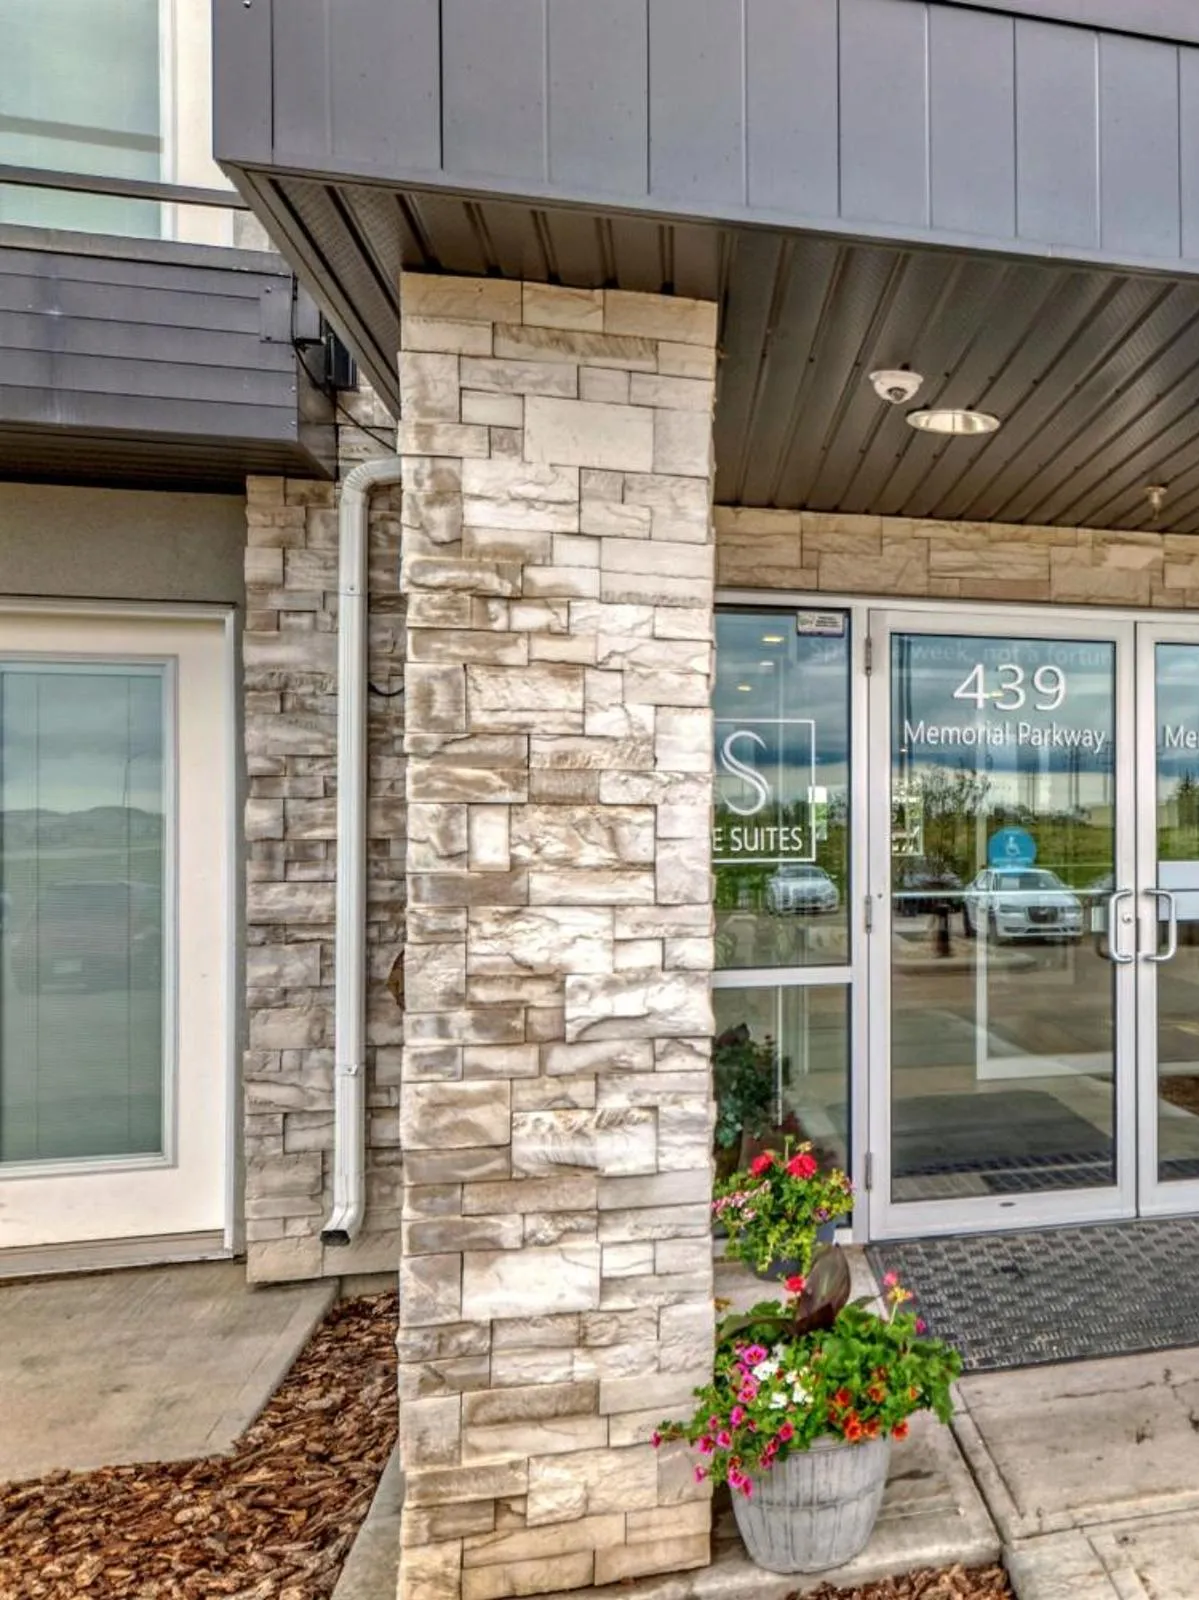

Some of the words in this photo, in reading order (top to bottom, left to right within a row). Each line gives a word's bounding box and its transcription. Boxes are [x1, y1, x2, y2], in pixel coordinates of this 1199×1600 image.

[953, 664, 1065, 710] 439
[904, 720, 1009, 745] Memorial
[1018, 721, 1106, 753] Parkway
[730, 827, 803, 851] SUITES
